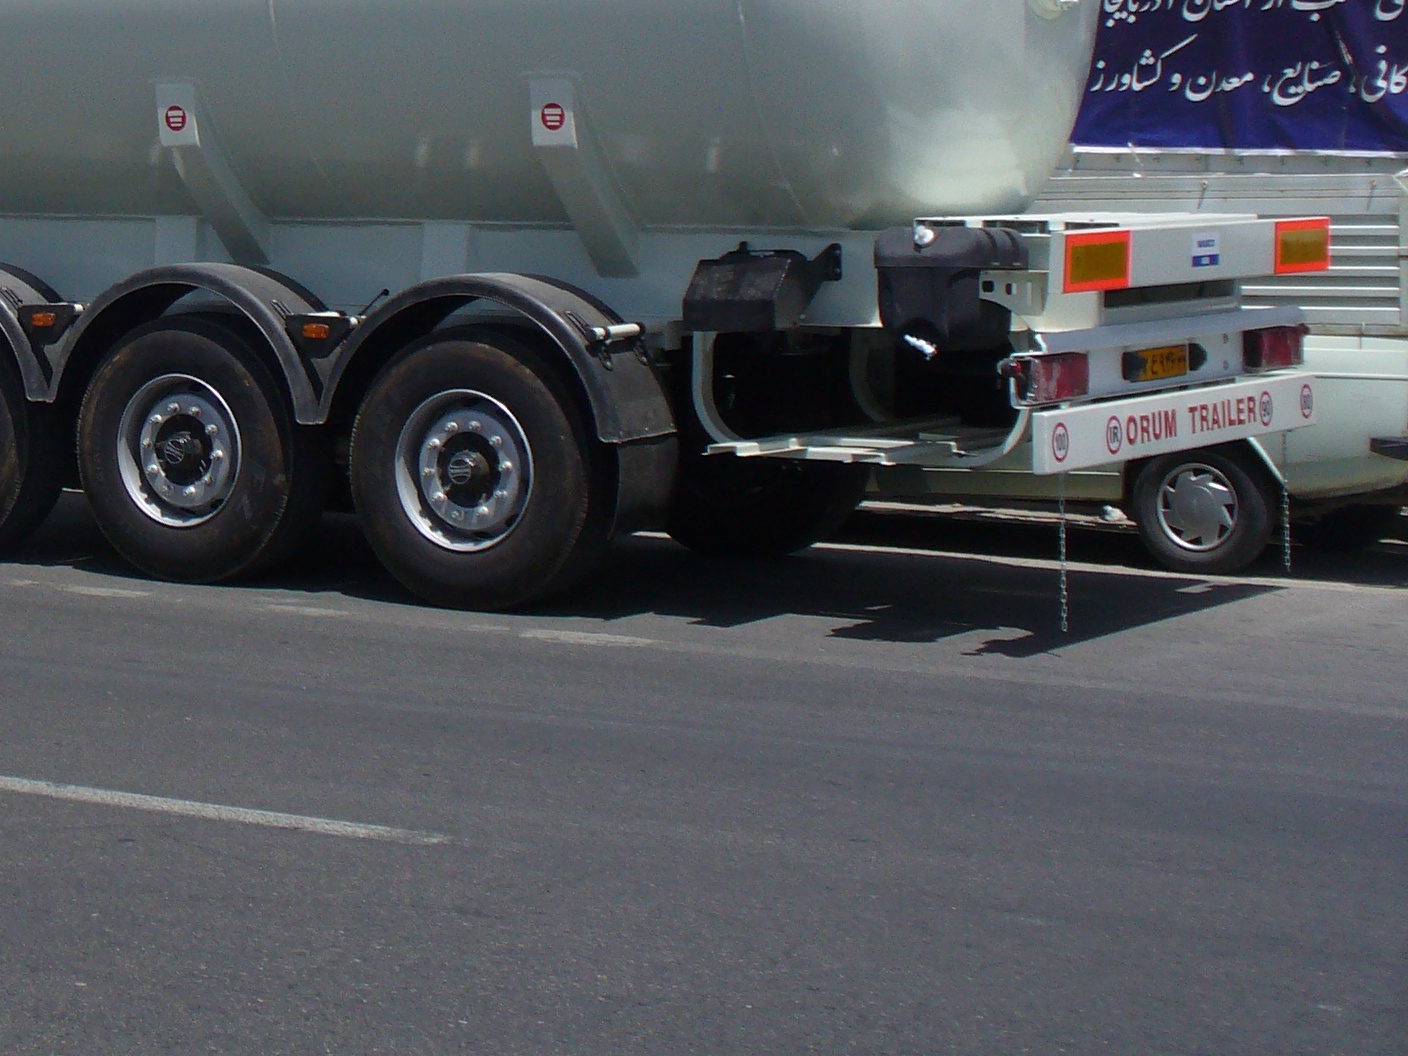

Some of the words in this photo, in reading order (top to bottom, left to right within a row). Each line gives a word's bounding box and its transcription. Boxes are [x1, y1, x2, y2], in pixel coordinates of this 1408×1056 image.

[1167, 71, 1182, 92] و
[1184, 69, 1255, 102] معدن
[1126, 408, 1178, 445] ORUM
[1188, 395, 1258, 434] TRAILER
